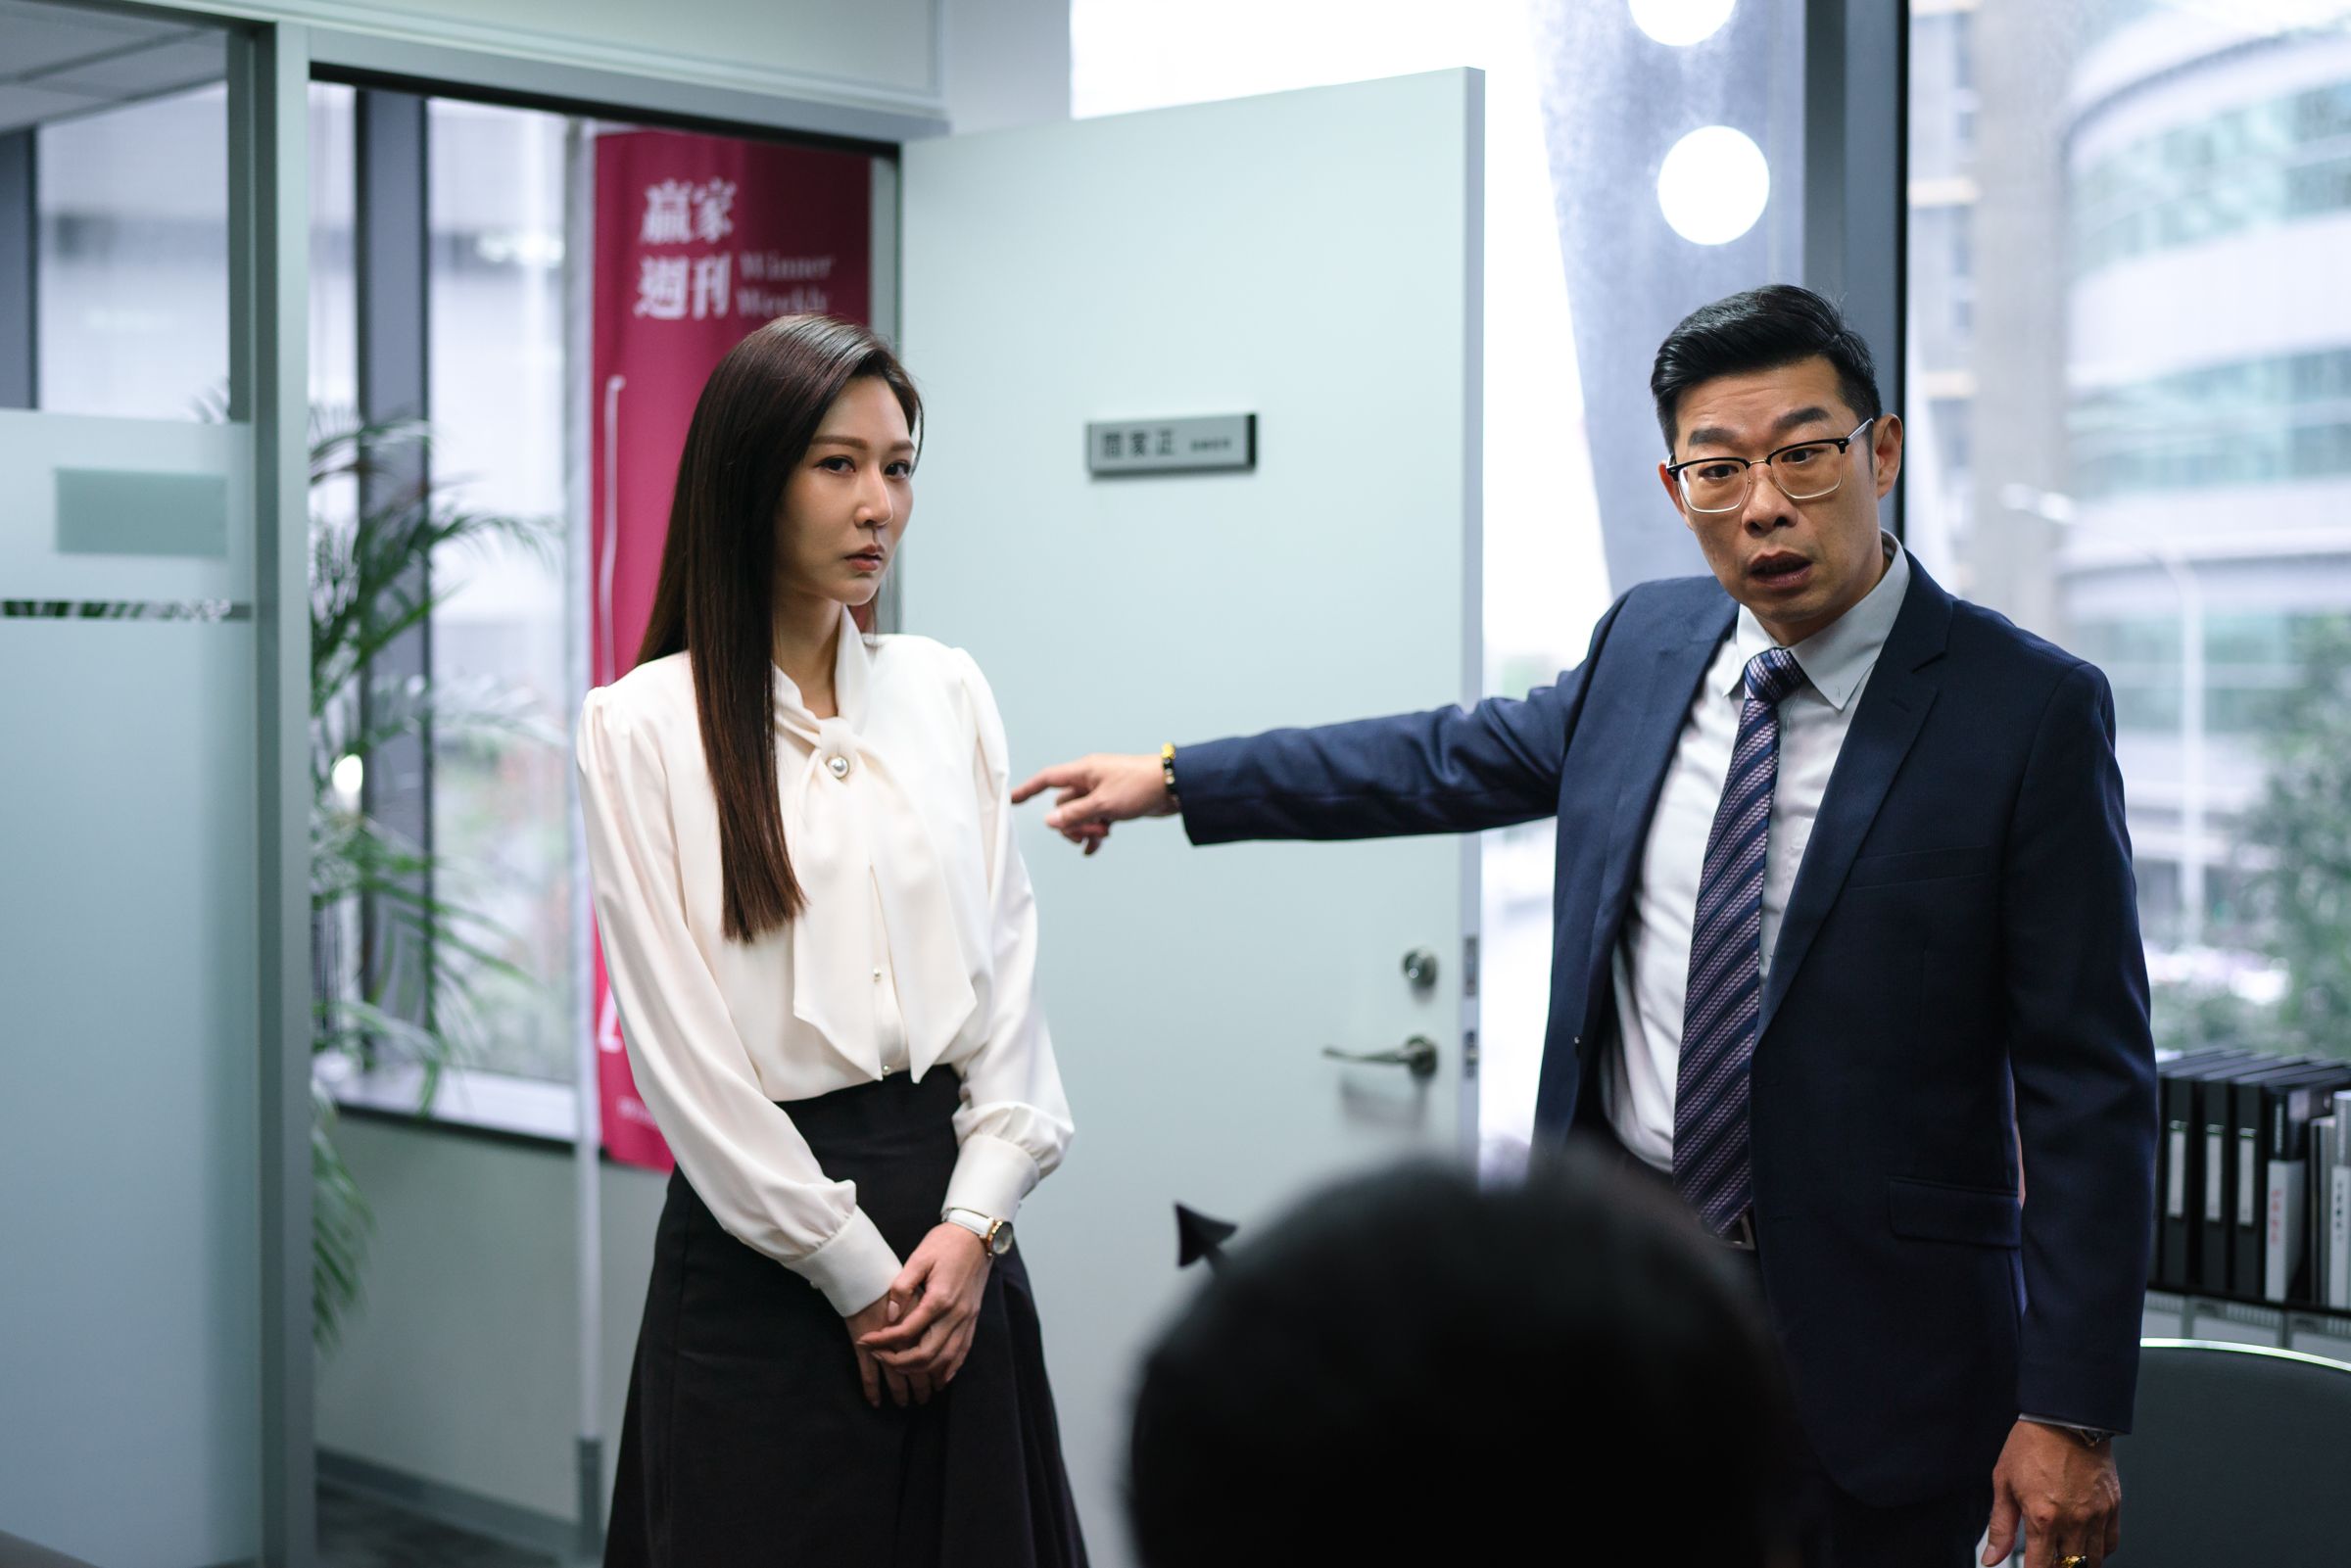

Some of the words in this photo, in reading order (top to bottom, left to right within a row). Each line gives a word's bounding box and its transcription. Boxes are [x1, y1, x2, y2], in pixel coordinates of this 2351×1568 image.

[641, 178, 736, 244] 贏家
[634, 251, 732, 319] 週刊
[739, 251, 833, 280] Winner
